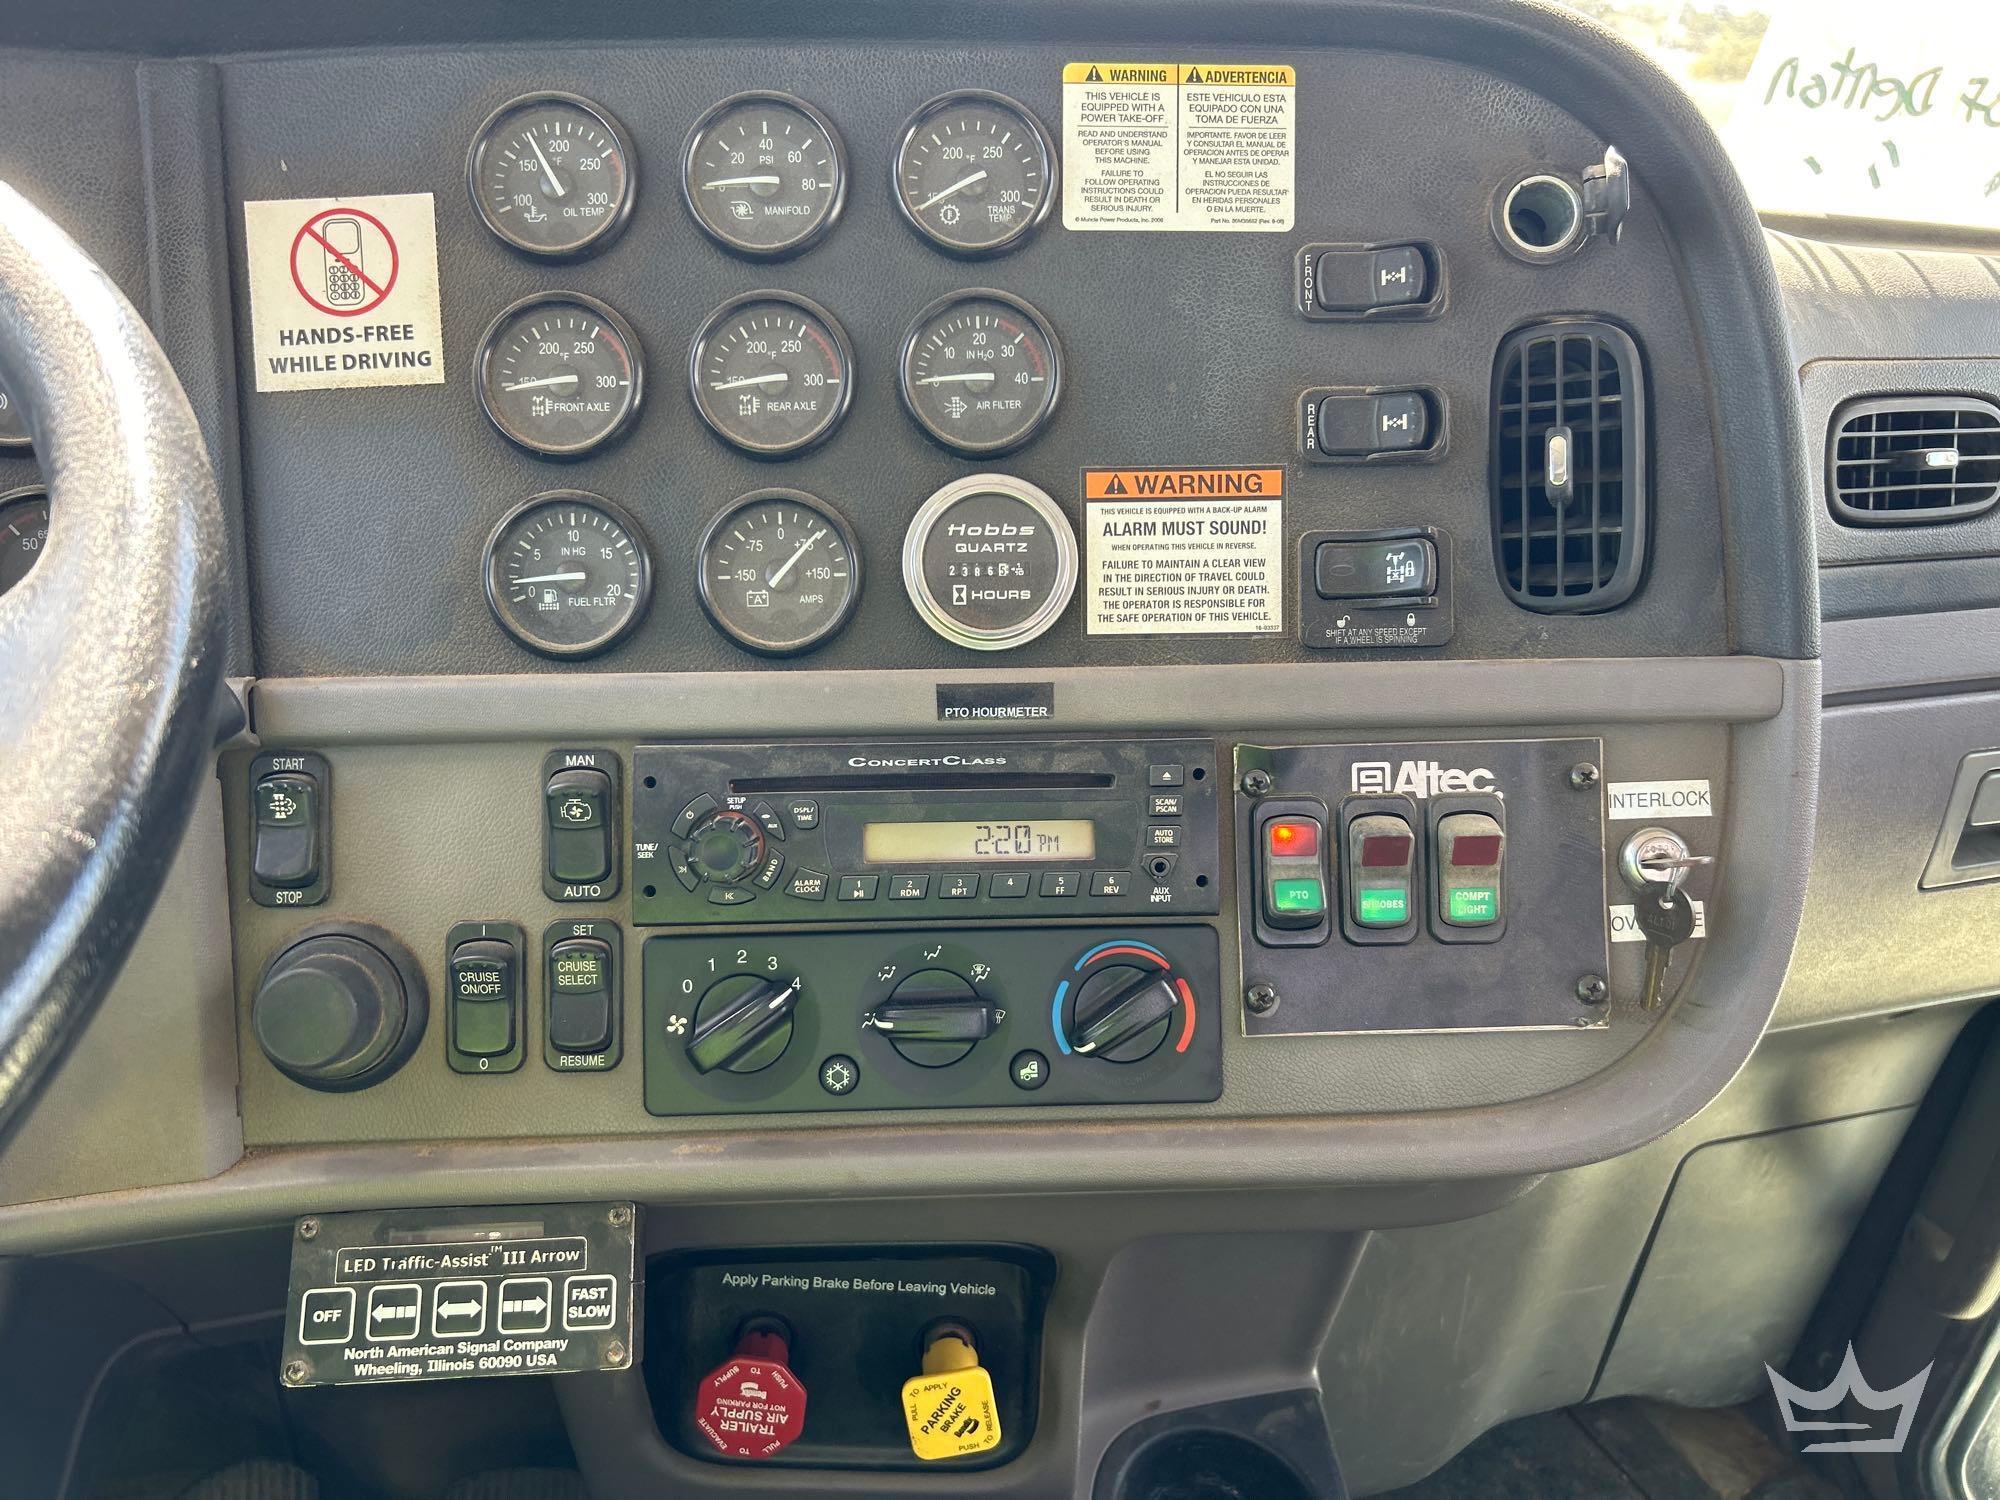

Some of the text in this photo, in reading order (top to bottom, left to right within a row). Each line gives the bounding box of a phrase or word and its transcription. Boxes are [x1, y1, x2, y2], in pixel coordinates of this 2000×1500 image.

[1110, 70, 1167, 82] WARNING
[1206, 71, 1287, 83] ADVERTENCIA
[1086, 92, 1160, 101] THIS VEHICLE IS
[1187, 93, 1286, 102] ESTE VEHICULO ESTA
[1081, 103, 1165, 112] EQUIPPED WITH A
[1189, 104, 1284, 113] EQUIPADO CON UNA
[1081, 114, 1116, 122] POWER
[1195, 115, 1278, 124] TOMA DE FUERZA
[549, 140, 569, 152] 200
[759, 138, 773, 150] 40
[788, 151, 802, 164] 60
[943, 147, 962, 159] 200
[983, 146, 1002, 158] 250
[580, 158, 600, 171] 250
[731, 152, 744, 165] 20
[759, 155, 774, 165] PSI
[519, 159, 537, 172] 150
[802, 179, 815, 191] 80
[513, 194, 532, 206] 100
[587, 192, 608, 206] 300
[1001, 191, 1020, 202] 300
[563, 207, 604, 217] OIL TEMP
[765, 205, 810, 216] MANIFOLD
[987, 206, 1015, 214] TRANS
[989, 214, 1012, 222] TEMP
[280, 324, 414, 346] HANDS-FREE
[973, 333, 986, 345] 20
[539, 343, 559, 354] 200
[574, 342, 594, 354] 250
[747, 341, 767, 353] 200
[781, 341, 801, 352] 250
[944, 347, 955, 358] 10
[1001, 346, 1014, 357] 30
[269, 351, 432, 374] WHILE DRIVING
[596, 376, 616, 388] 300
[804, 374, 823, 386] 300
[1014, 372, 1028, 384] 40
[555, 402, 610, 412] FRONT AXLE
[767, 402, 817, 411] REAR AXLE
[977, 401, 1021, 409] AIR FILTER
[1307, 404, 1315, 449] REAR
[1134, 474, 1263, 494] WARNING
[948, 523, 1035, 536] Hobbs
[1103, 520, 1266, 536] ALARM MUST SOUND!
[568, 530, 579, 542] 10
[22, 538, 38, 550] 50
[955, 543, 1028, 552] QUARTZ
[601, 548, 612, 559] 15
[1103, 558, 1266, 569] FAILURE TO MAINTAIN A CLEAR VIEW
[735, 570, 756, 581] -150
[806, 568, 830, 579] +150
[607, 584, 621, 596] 20
[972, 590, 1031, 600] HOURS
[568, 597, 616, 606] FUEL FLTR
[800, 595, 823, 603] AMPS
[945, 707, 1047, 717] PTO HOURMETER
[273, 758, 304, 770] START
[566, 755, 594, 766] MAN
[1609, 791, 1710, 808] INTERLOCK
[975, 825, 1059, 854] 2:20 PM
[763, 859, 778, 881] BAND
[564, 886, 600, 896] AUTO
[1290, 891, 1308, 899] PTO
[1456, 892, 1490, 900] COMPT
[276, 892, 302, 903] STOP
[1458, 905, 1487, 914] LIGHT
[573, 925, 593, 935] SET
[737, 950, 747, 963] 2
[558, 961, 596, 972] CRUISE
[708, 958, 715, 971] 1
[768, 957, 778, 970] 3
[460, 972, 499, 982] CRUISE
[558, 975, 597, 985] SELECT
[461, 984, 501, 993] ON/OFF
[682, 979, 692, 993] 0
[792, 977, 801, 990] 4
[560, 1055, 605, 1066] RESUME
[345, 1258, 376, 1273] LED
[503, 1252, 525, 1265] III
[530, 1248, 580, 1263] Arrow
[722, 1273, 995, 1295] Apply Parking Brake Before Leaving Vehicle
[572, 1287, 608, 1300] FAST
[313, 1310, 342, 1322] OFF
[568, 1305, 610, 1319] SLOW
[344, 1337, 569, 1360] North American Signal Company
[354, 1354, 557, 1377] Wheeling, Illinois 60090 USA
[711, 1406, 788, 1424] AIR SUPPLY
[920, 1387, 961, 1434] PARKING
[940, 1403, 966, 1432] BRAKE
[720, 1420, 775, 1435] TRAILER
